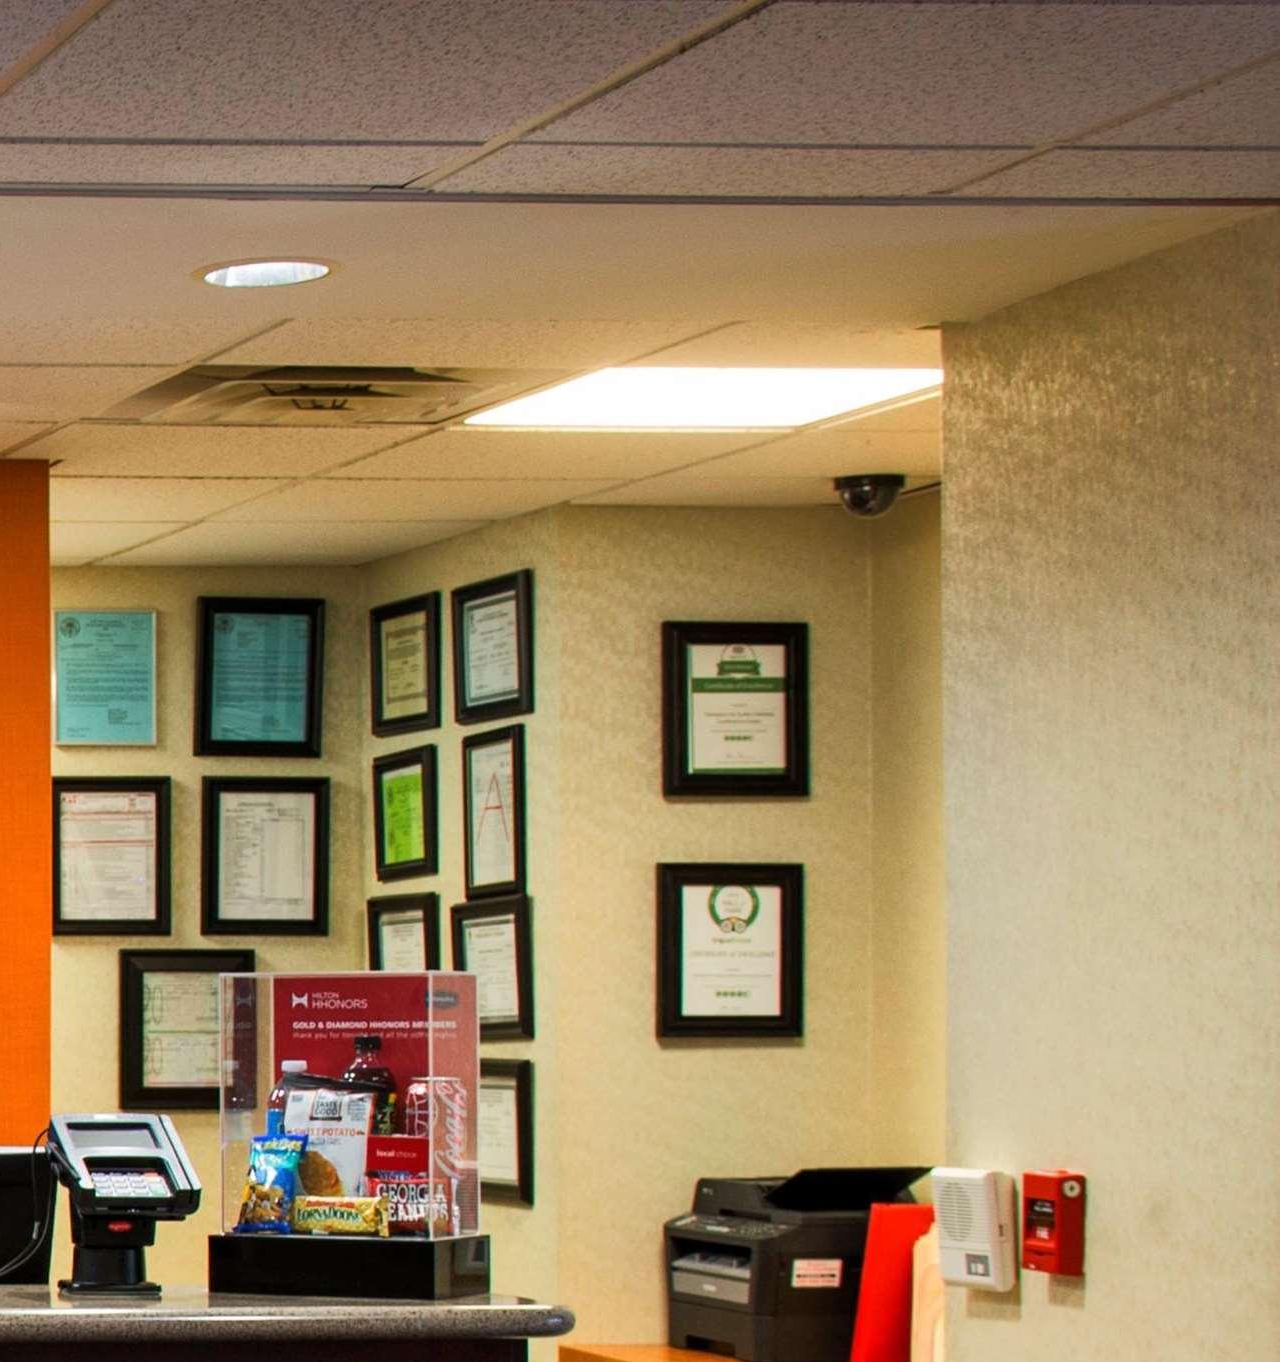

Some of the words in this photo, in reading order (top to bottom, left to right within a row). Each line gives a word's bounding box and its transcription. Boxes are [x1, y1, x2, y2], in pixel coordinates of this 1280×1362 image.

[311, 999, 368, 1009] HHONORS
[293, 1021, 316, 1029] GOLD
[317, 1021, 325, 1029] &
[326, 1021, 367, 1029] DIAMOND
[369, 1021, 410, 1029] HHONORS
[412, 1021, 457, 1029] MEBERS
[321, 1127, 356, 1136] POTATO
[376, 1149, 395, 1157] local
[387, 1203, 449, 1221] EANUTS
